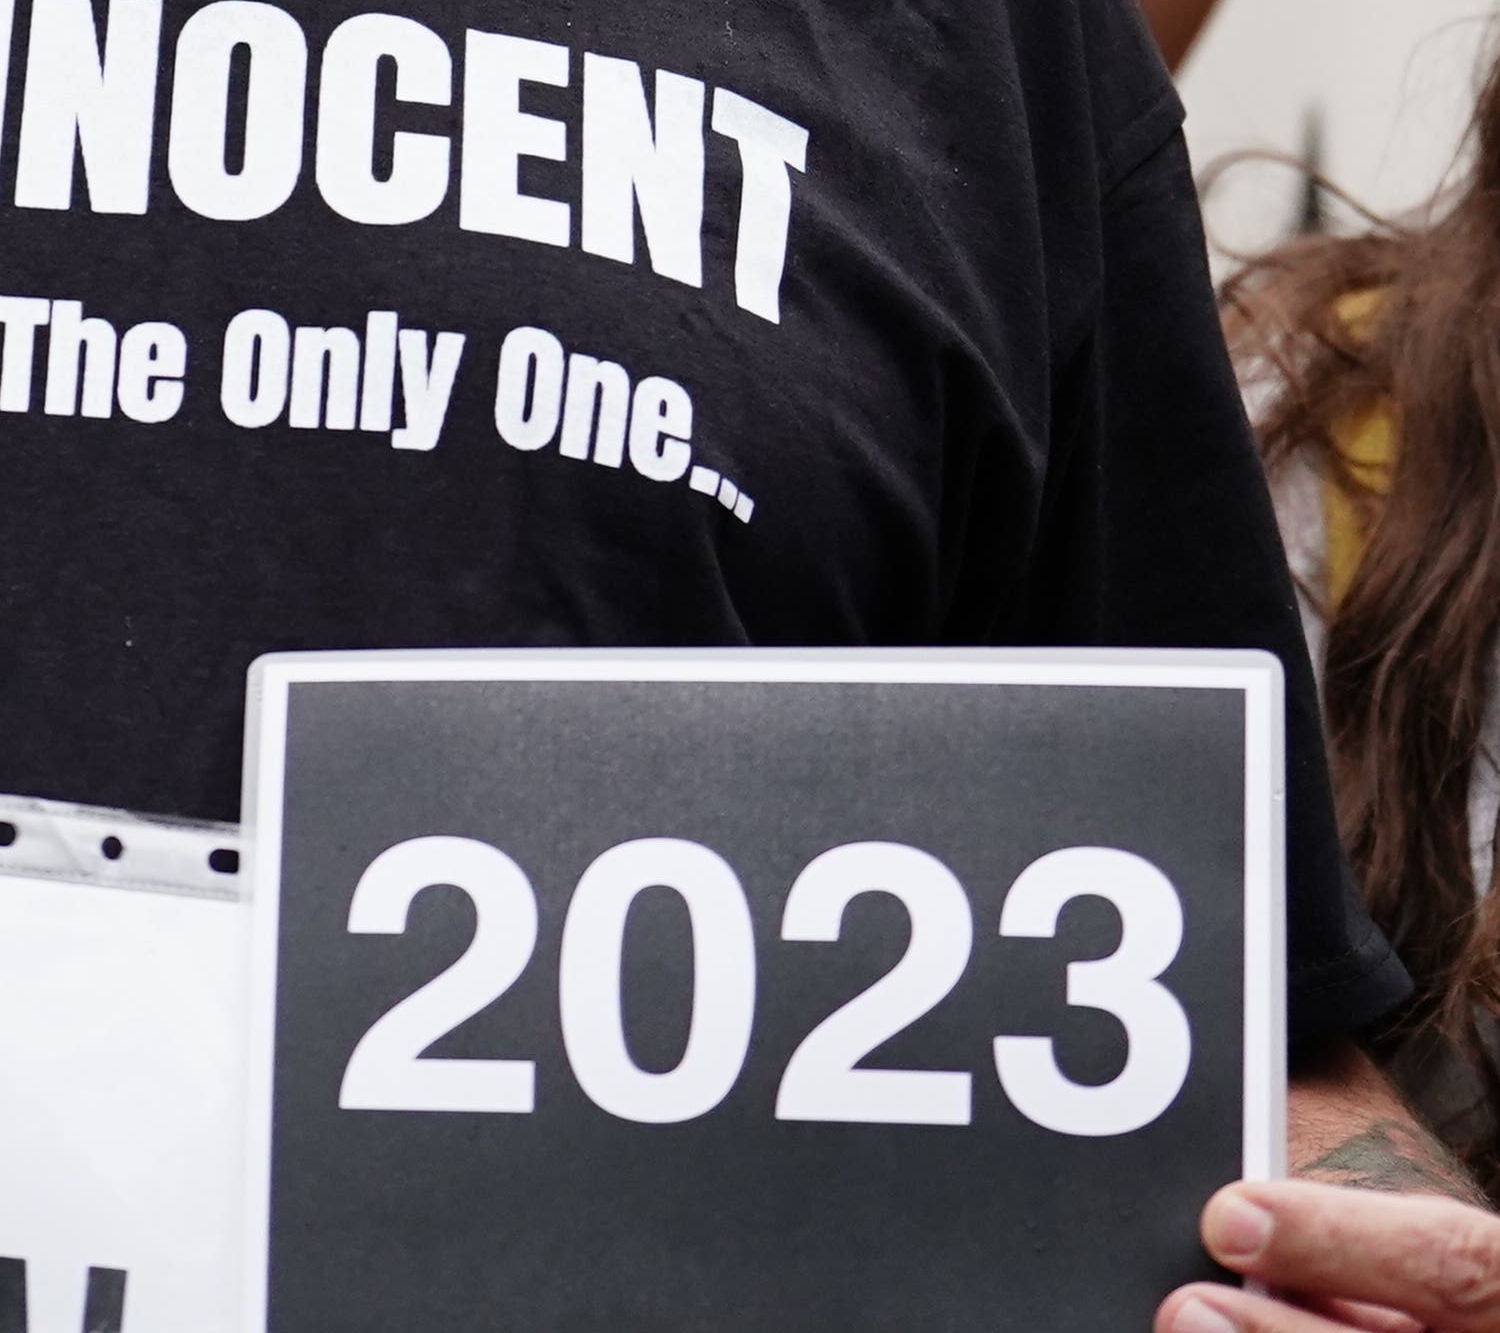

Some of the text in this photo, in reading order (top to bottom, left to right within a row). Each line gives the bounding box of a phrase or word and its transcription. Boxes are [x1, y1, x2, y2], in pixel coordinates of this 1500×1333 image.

[221, 309, 465, 451] Only
[495, 327, 754, 523] One...
[339, 836, 1190, 1135] 2023
